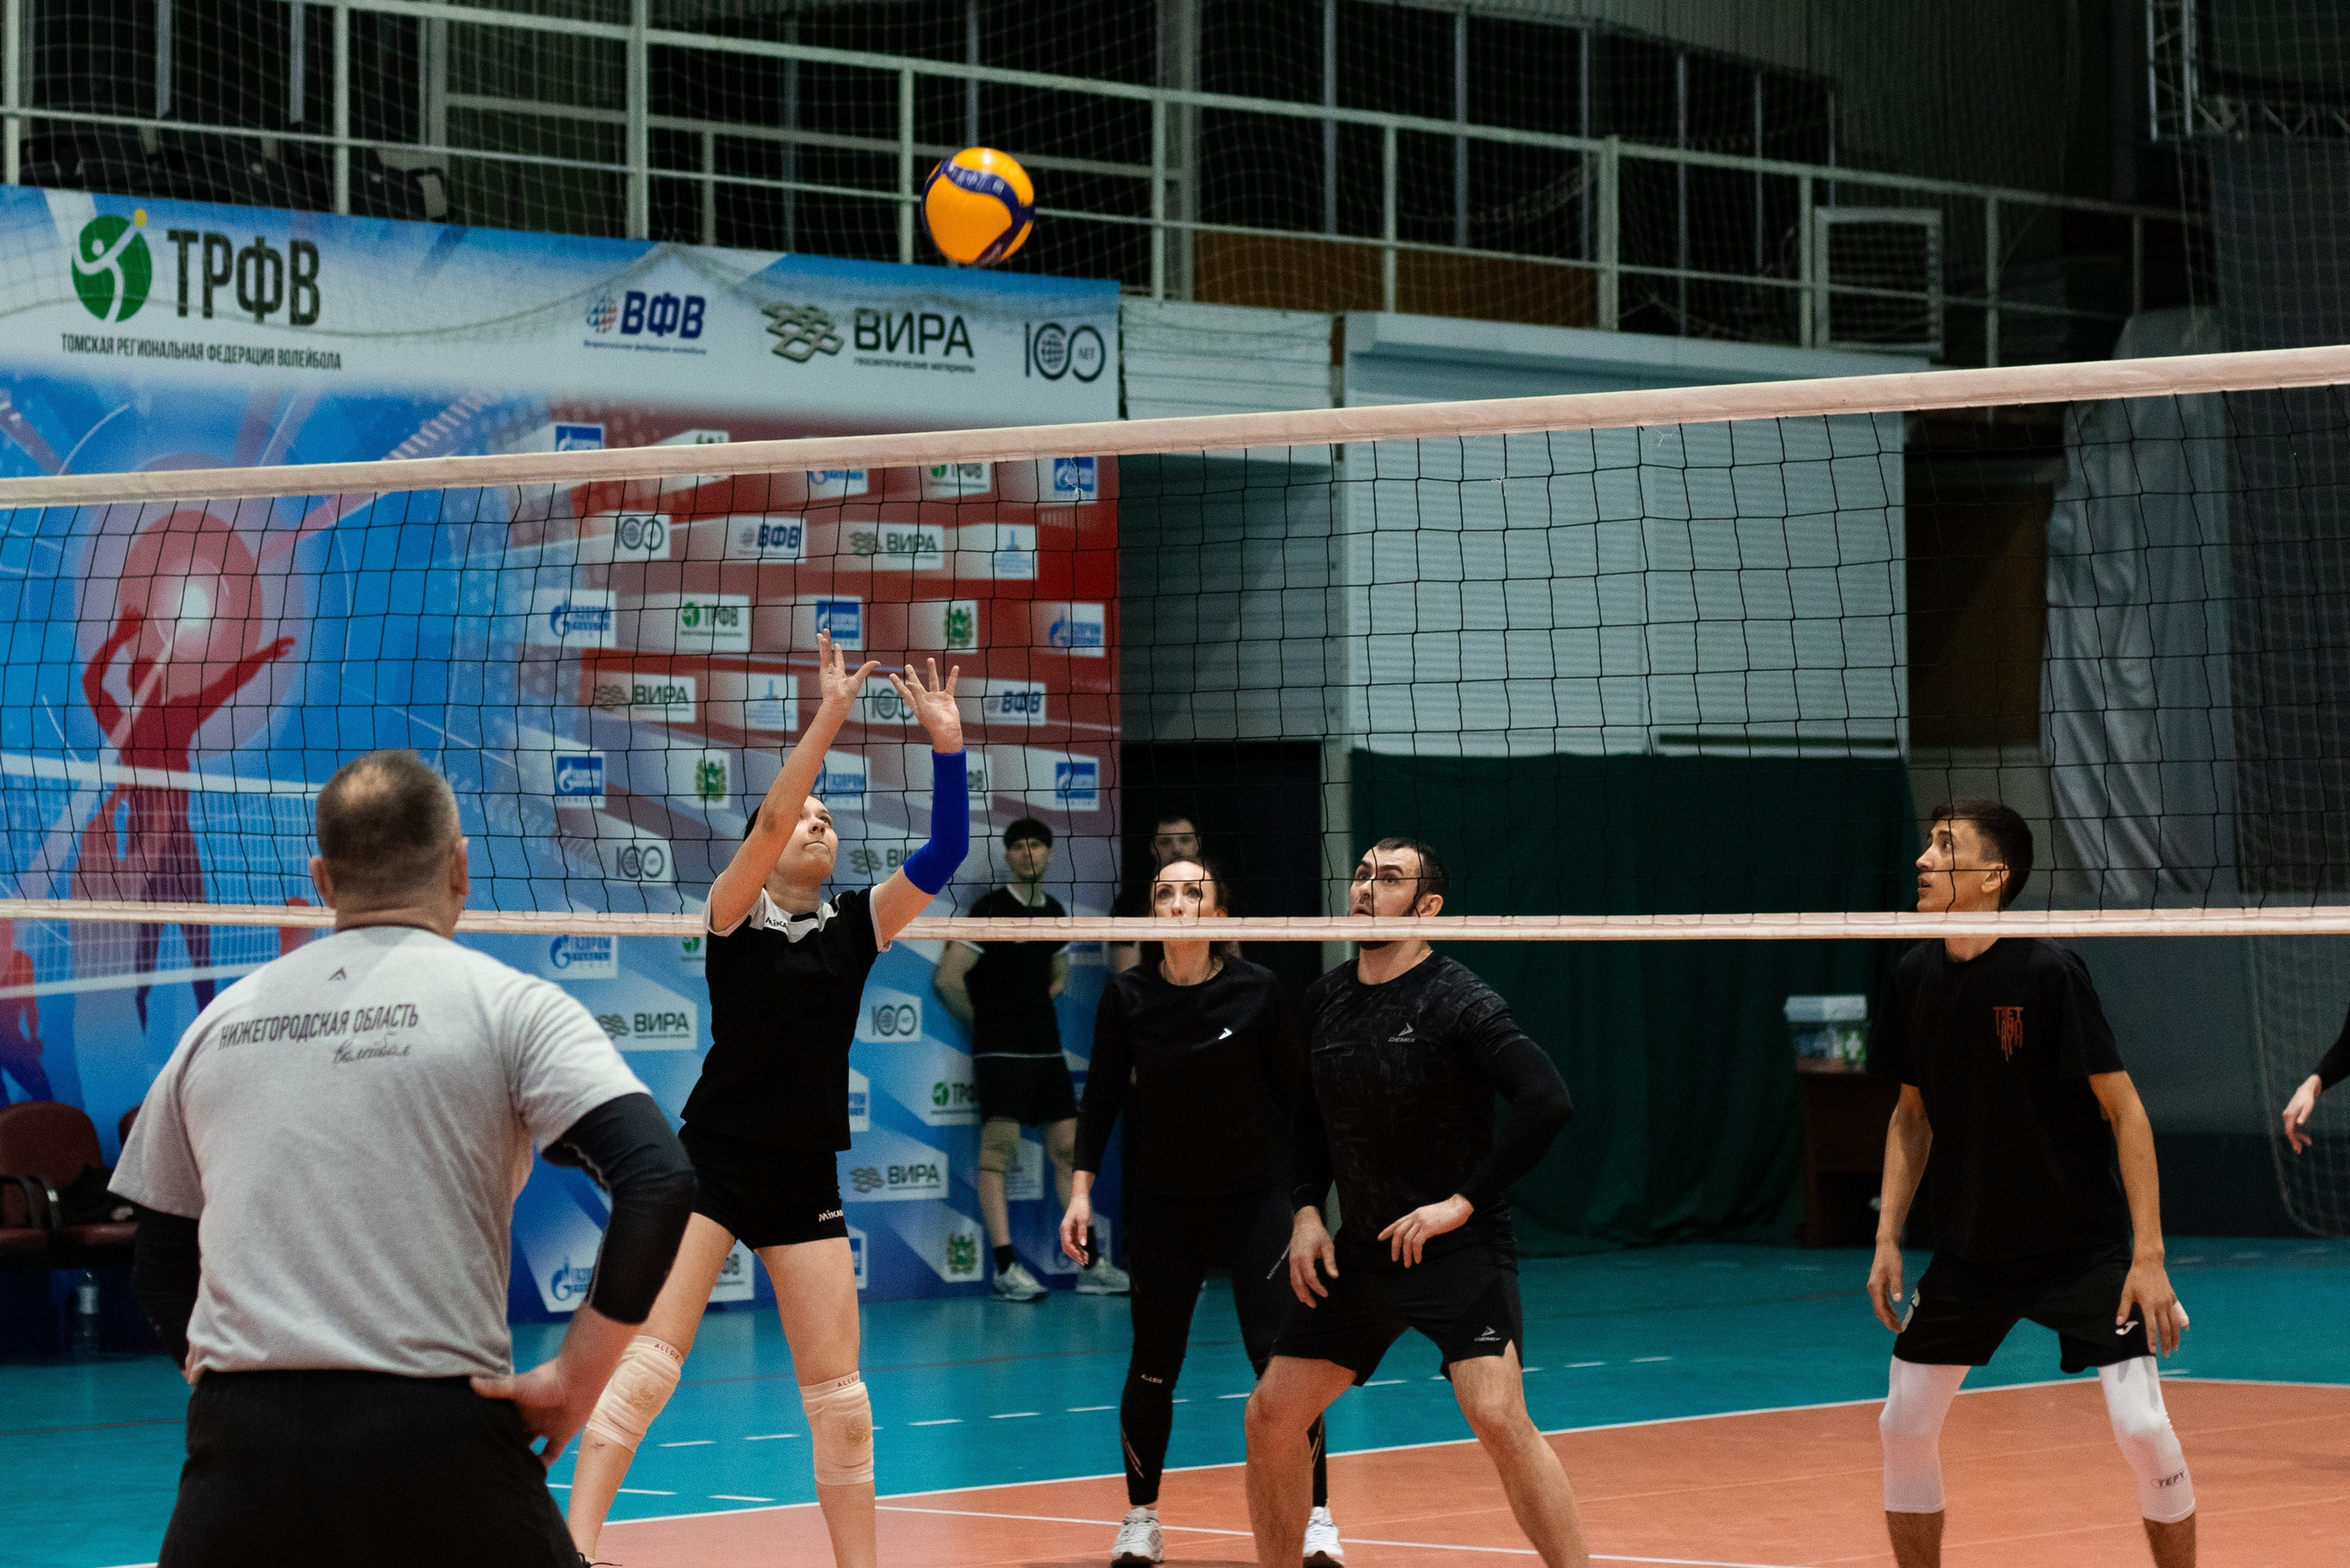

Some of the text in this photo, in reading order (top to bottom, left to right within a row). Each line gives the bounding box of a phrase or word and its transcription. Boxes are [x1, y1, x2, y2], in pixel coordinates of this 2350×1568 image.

[167, 229, 320, 326] ТРФВ
[621, 290, 706, 339] ВФВ
[854, 308, 974, 358] ВИРА
[61, 332, 342, 370] ТОМСКАЯ РЕГИОНАЛЬНАЯ ФЕДЕРАЦИЯ ВОЛЕЙБОЛА
[757, 524, 800, 549] ВФВ
[886, 532, 937, 553] ВИРА
[703, 604, 738, 627] ТРФВ
[633, 685, 688, 704] ВИРА
[1002, 690, 1043, 713] ВФВ
[218, 1004, 419, 1050] НИЖЕГОРОДСКАЯ ОБЛАСТЬ
[634, 1013, 689, 1033] ВИРА
[888, 1164, 940, 1185] ВИРА
[655, 1343, 680, 1360] ALLSIX
